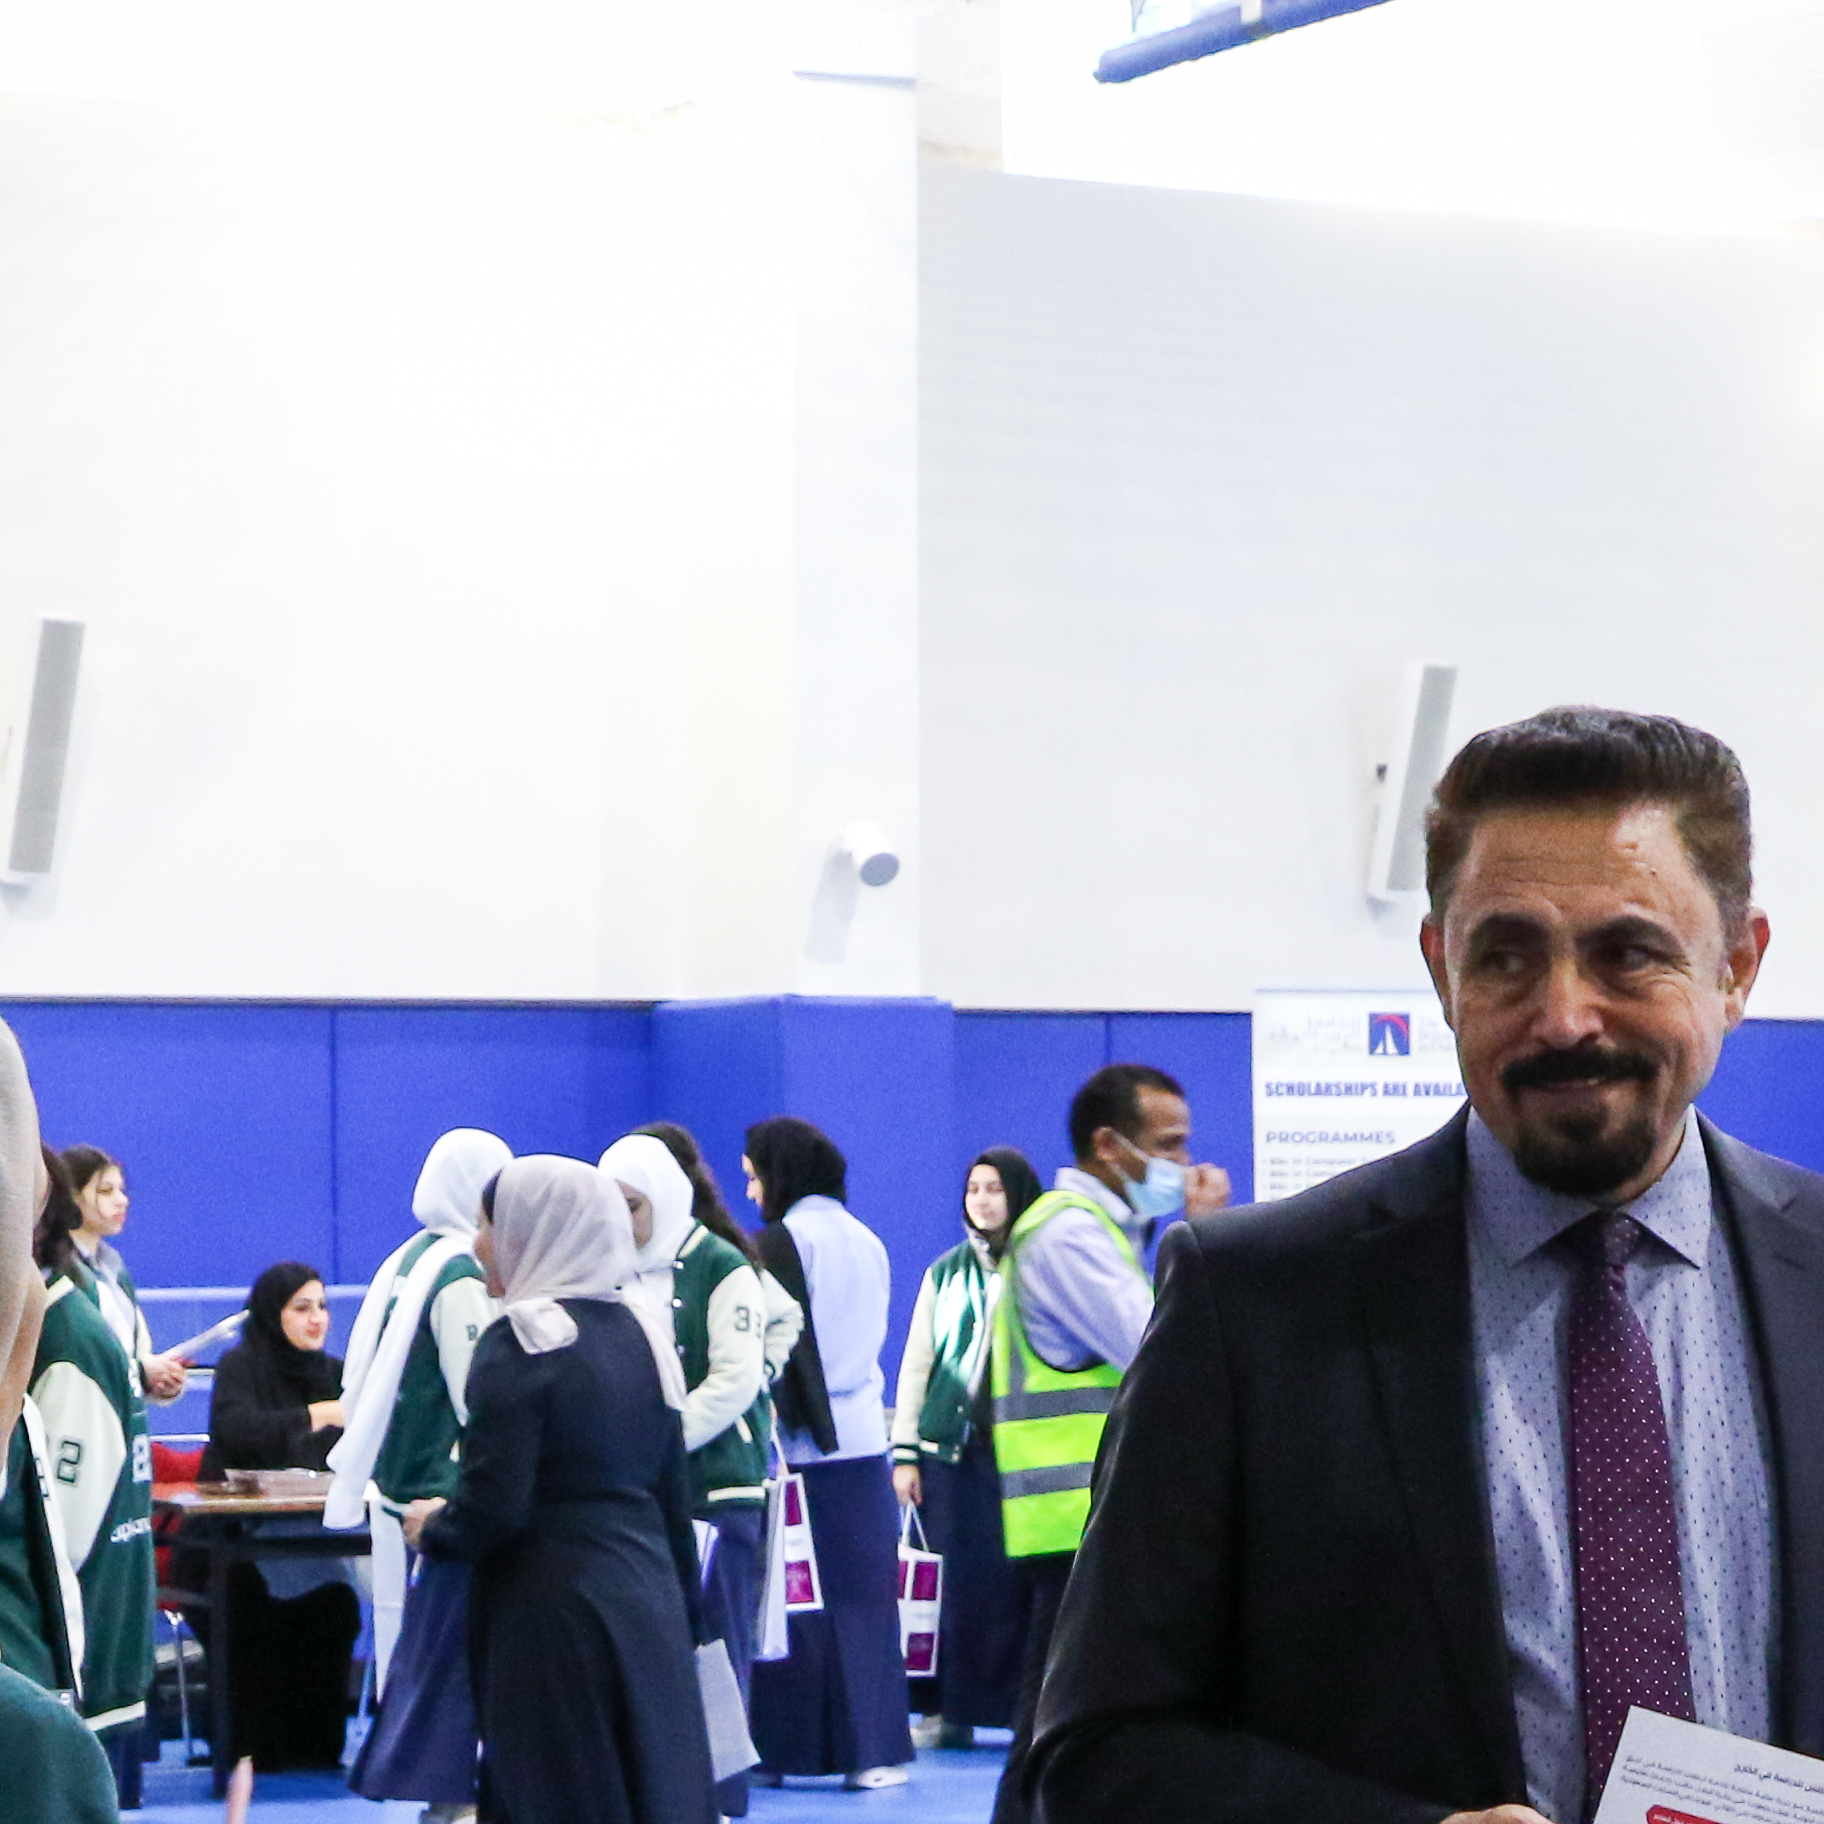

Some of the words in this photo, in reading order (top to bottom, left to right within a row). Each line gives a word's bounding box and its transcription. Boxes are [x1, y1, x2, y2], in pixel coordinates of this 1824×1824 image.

[1265, 1081, 1378, 1097] SCHOLARSHIPS
[1382, 1081, 1407, 1097] ARE
[1266, 1131, 1396, 1144] PROGRAMMES
